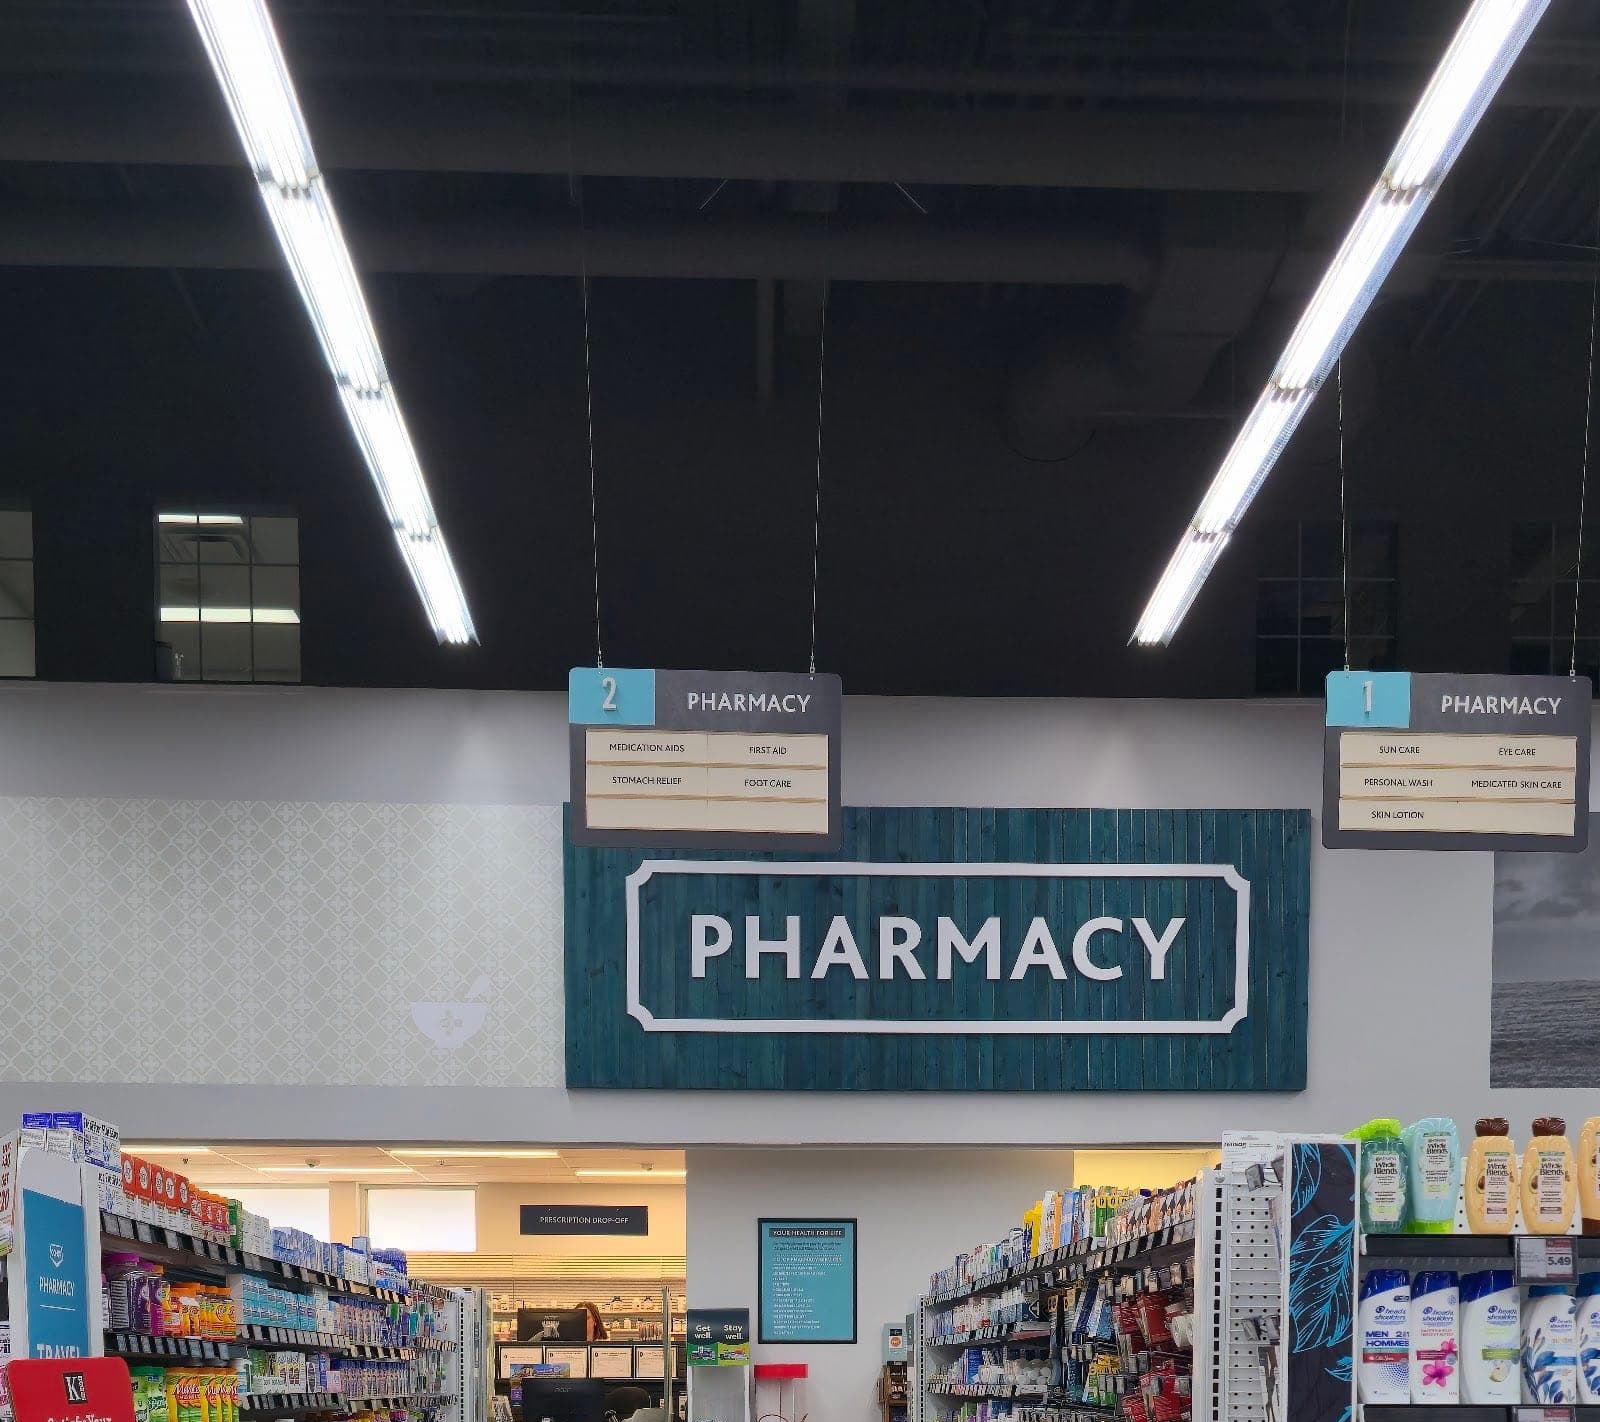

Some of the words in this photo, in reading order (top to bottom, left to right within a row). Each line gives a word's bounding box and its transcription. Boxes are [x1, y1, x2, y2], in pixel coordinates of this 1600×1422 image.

[602, 677, 617, 711] 2
[1363, 680, 1373, 712] 1
[687, 692, 812, 713] PHARMACY
[1441, 695, 1562, 715] PHARMACY
[609, 743, 663, 753] MEDICATION
[665, 744, 685, 753] AIDS
[749, 746, 771, 756] FIRST
[773, 747, 787, 756] AID
[1378, 745, 1397, 755] SUN
[1398, 746, 1420, 755] CARE
[1498, 748, 1513, 757] EYE
[1515, 748, 1536, 757] CARE
[612, 776, 654, 786] STOMACH
[656, 776, 682, 786] RELIEF
[744, 779, 768, 789] FOOT
[769, 779, 791, 789] CARE
[1364, 778, 1406, 788] PERSONAL
[1408, 779, 1433, 788] WASH
[1471, 780, 1518, 789] MEDICATED
[1520, 781, 1539, 789] SKIN
[1540, 781, 1562, 790] CARE
[1371, 811, 1391, 820] SKIN
[1392, 811, 1424, 820] LOTION
[691, 914, 1186, 981] PHARMACY
[540, 1216, 591, 1224] PRESCRIPTION
[1547, 1256, 1572, 1266] 5.49
[39, 1276, 76, 1297] PHARMACY
[723, 1324, 743, 1333] Stay
[725, 1332, 744, 1340] well.
